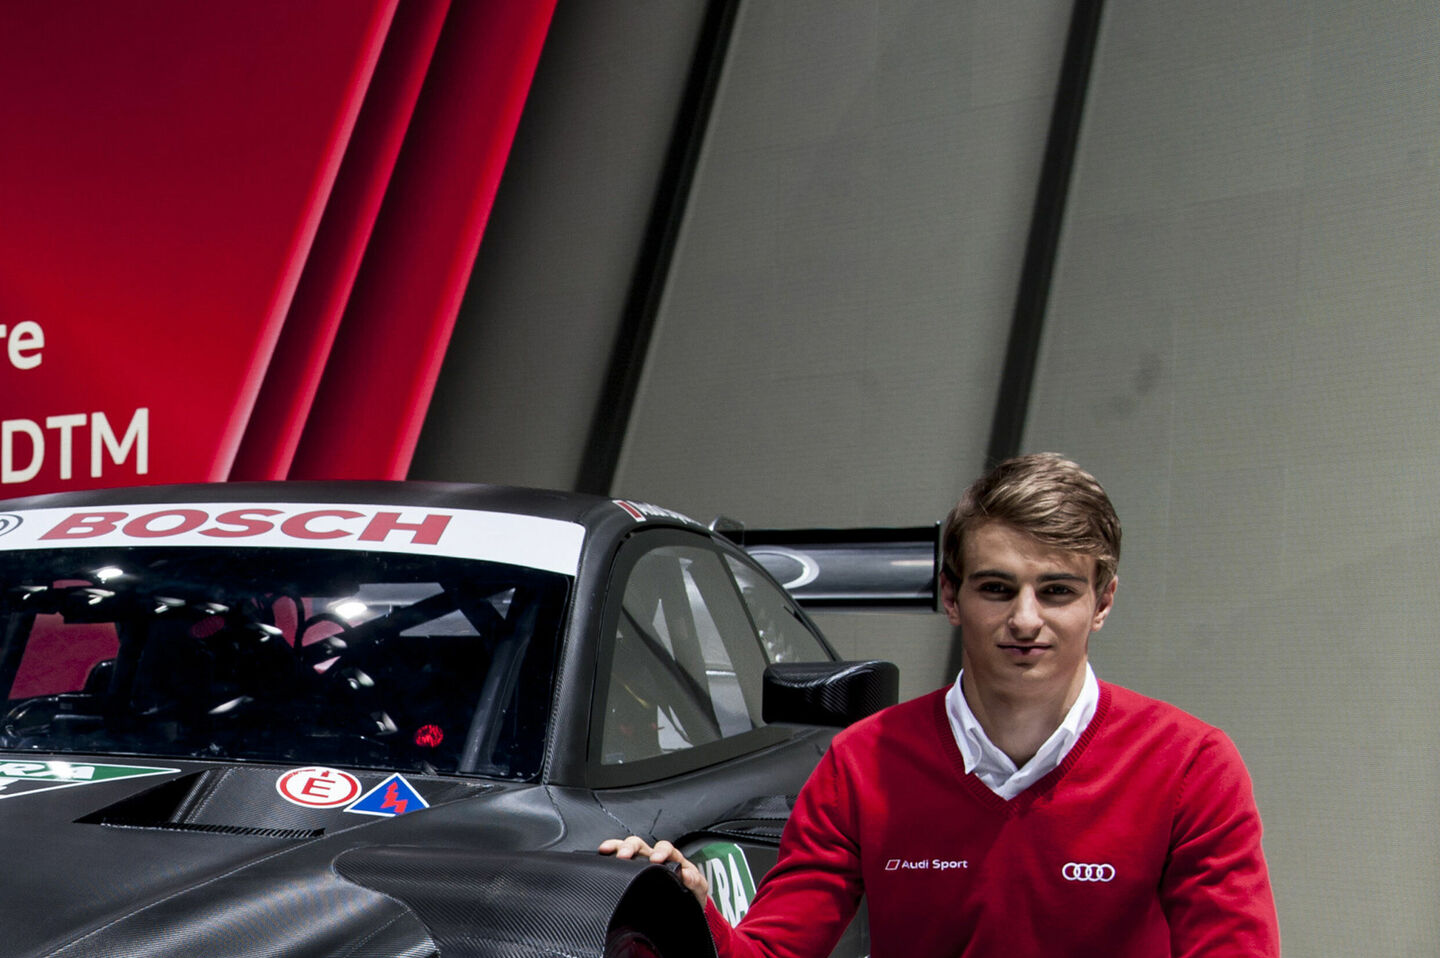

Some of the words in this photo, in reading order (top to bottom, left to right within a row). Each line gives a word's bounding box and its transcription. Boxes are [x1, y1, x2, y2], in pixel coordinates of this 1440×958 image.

[1, 408, 149, 484] DTM
[38, 508, 452, 546] BOSCH
[901, 859, 929, 870] Audi
[932, 859, 969, 872] Sport
